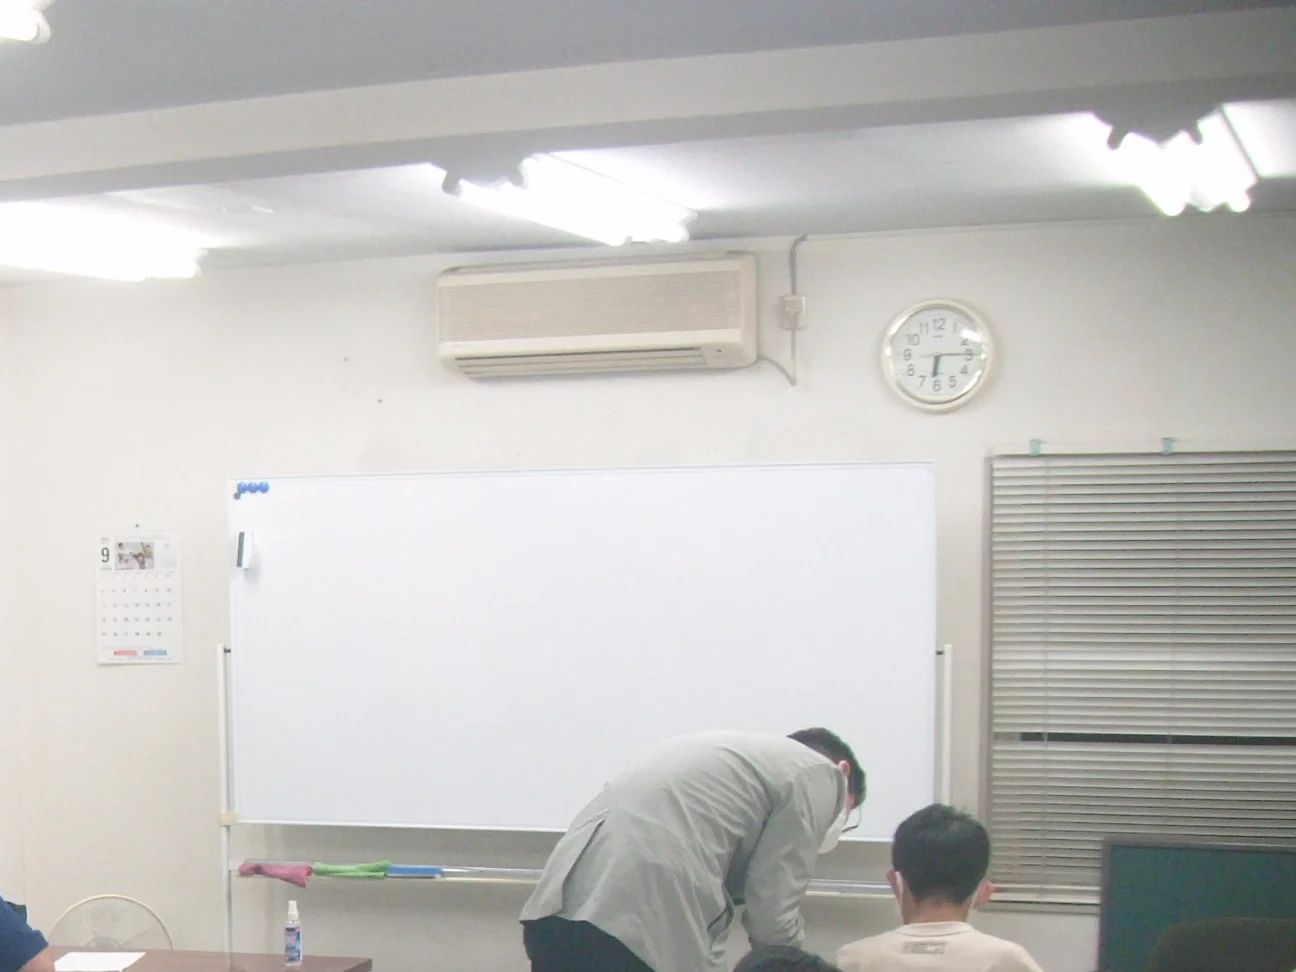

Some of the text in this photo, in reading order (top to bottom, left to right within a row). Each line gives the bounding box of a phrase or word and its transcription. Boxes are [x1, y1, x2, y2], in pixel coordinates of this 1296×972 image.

[919, 322, 929, 335] 11
[932, 317, 946, 330] 12
[907, 333, 920, 346] 10
[904, 348, 912, 361] 9
[964, 348, 974, 361] 3
[906, 363, 915, 377] 8
[959, 364, 969, 375] 4
[918, 375, 927, 387] 7
[932, 379, 942, 393] 6
[948, 375, 957, 388] 5
[100, 546, 111, 563] 9
